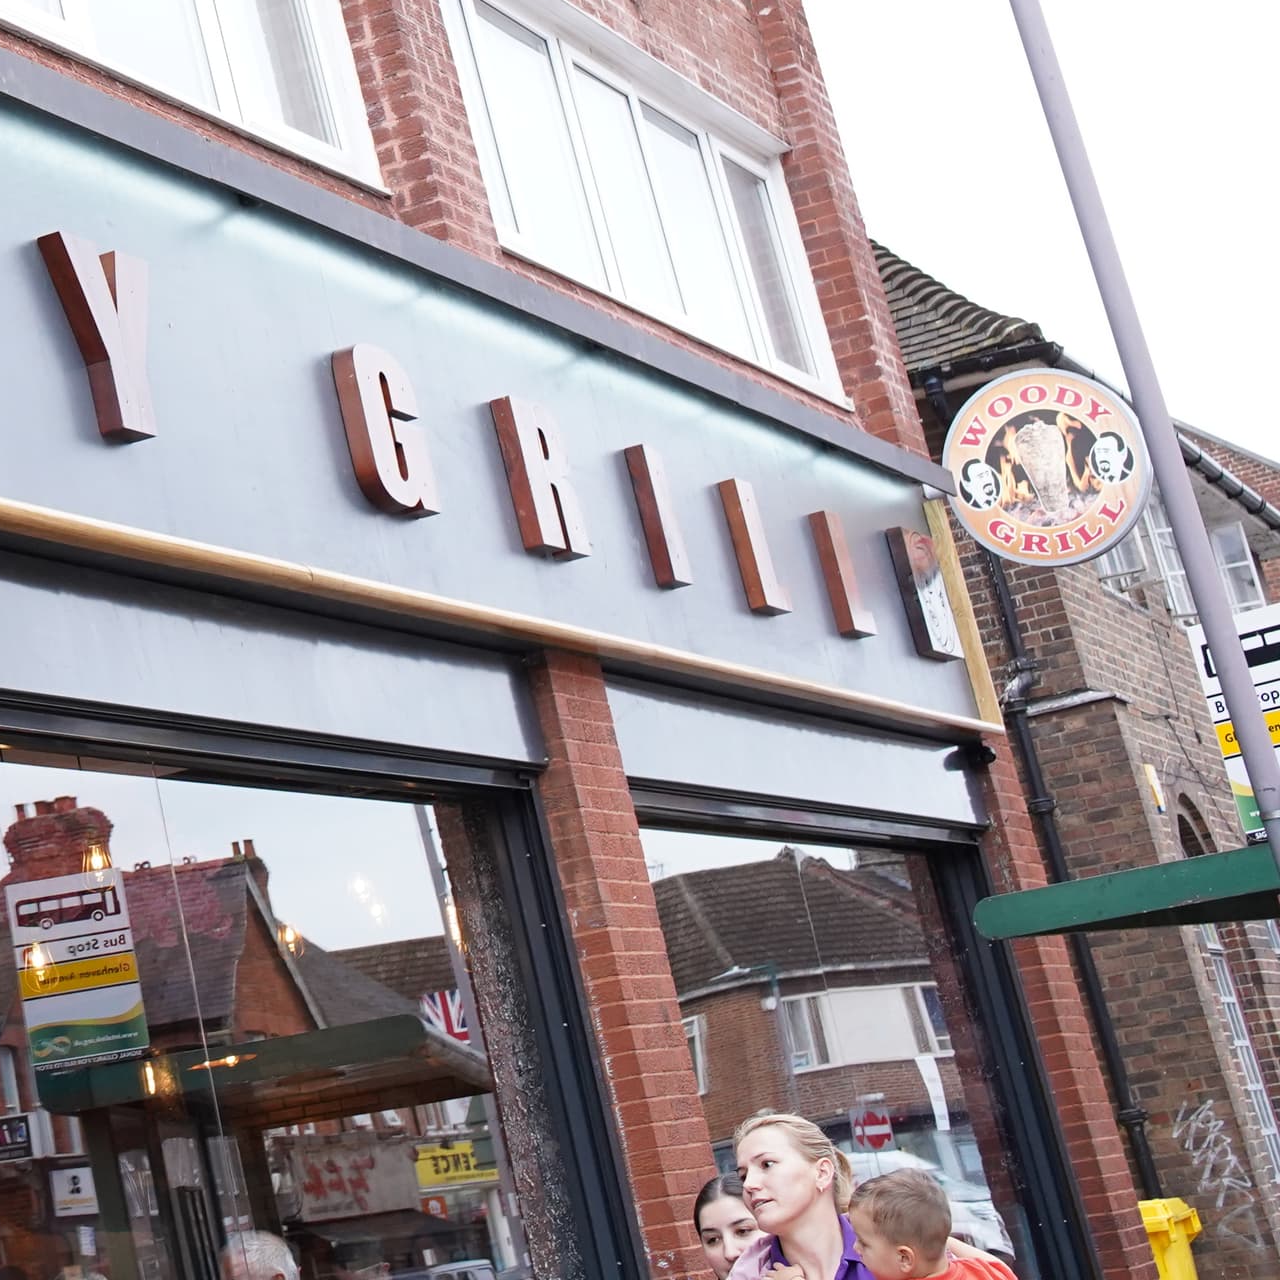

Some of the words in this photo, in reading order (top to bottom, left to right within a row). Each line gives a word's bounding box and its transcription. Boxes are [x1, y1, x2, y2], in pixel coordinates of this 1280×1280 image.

[959, 385, 1112, 449] WOODY
[331, 344, 878, 639] GRILL
[989, 499, 1125, 554] GRILL
